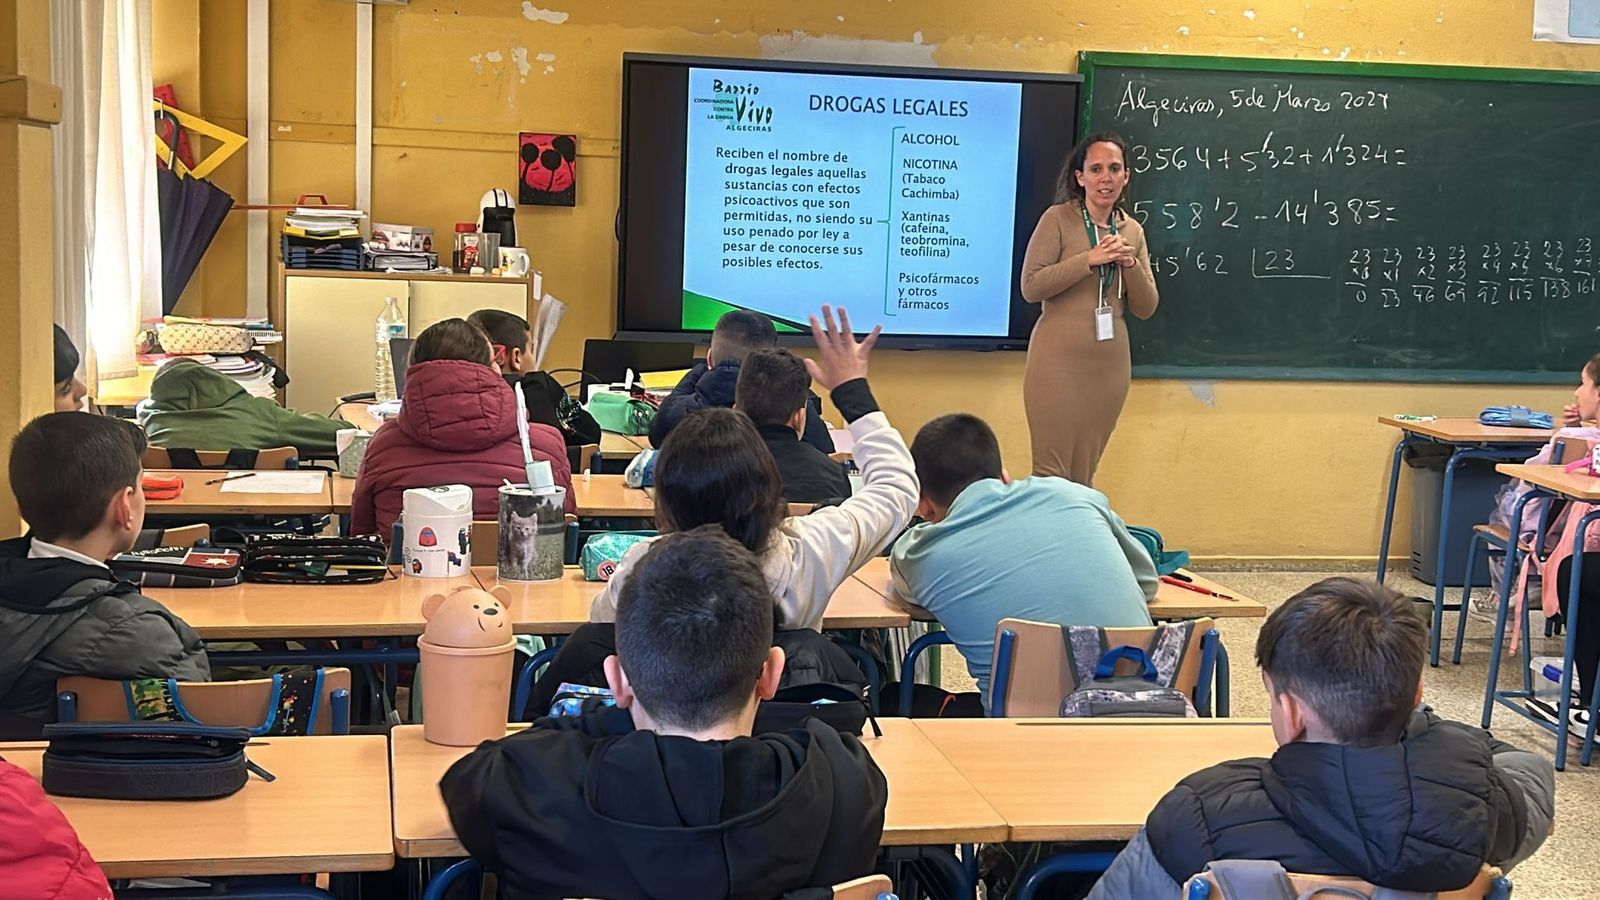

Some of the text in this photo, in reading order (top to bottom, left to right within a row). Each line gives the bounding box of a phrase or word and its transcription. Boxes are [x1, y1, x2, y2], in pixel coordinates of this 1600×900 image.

[713, 79, 759, 95] Barrio
[735, 96, 773, 124] Vivo
[809, 94, 968, 117] DROGAS LEGALES
[1117, 81, 1224, 127] Algeciras,
[1272, 84, 1330, 112] Marzo
[901, 133, 960, 146] ALCOHOL
[716, 147, 848, 163] Reciben el nombre de
[725, 163, 866, 180] drogas legales aquellas
[902, 158, 958, 170] NICOTINA
[902, 173, 946, 185] (Tabaco
[724, 180, 861, 194] sustancias con efectos
[901, 188, 960, 201] Cachimba)
[724, 194, 850, 210] psicoactivos que son
[723, 210, 873, 225] permitidas, no siendo su
[901, 211, 950, 222] Xantinas
[723, 226, 850, 241] uso penado por ley a
[901, 222, 949, 235] (cafeína,
[722, 241, 863, 255] pesar de conocerse sus
[901, 235, 969, 247] teobromina,
[1576, 238, 1592, 252] 23
[900, 246, 950, 258] teofilina)
[1350, 248, 1371, 264] 23
[1416, 245, 1436, 261] 23
[1448, 245, 1466, 260] 23
[1482, 242, 1501, 258] 23
[1513, 241, 1531, 259] 23
[1543, 240, 1563, 258] 23
[722, 257, 823, 269] posibles efectos.
[1265, 249, 1295, 270] 23
[1383, 248, 1402, 266] 23
[899, 272, 979, 285] Psicofármacos
[1577, 277, 1595, 294] 161
[898, 287, 937, 297] y otros
[1413, 288, 1435, 303] 46
[1509, 283, 1533, 301] 115
[1544, 280, 1571, 298] 138
[898, 298, 950, 310] fármacos
[602, 565, 615, 576] 18
